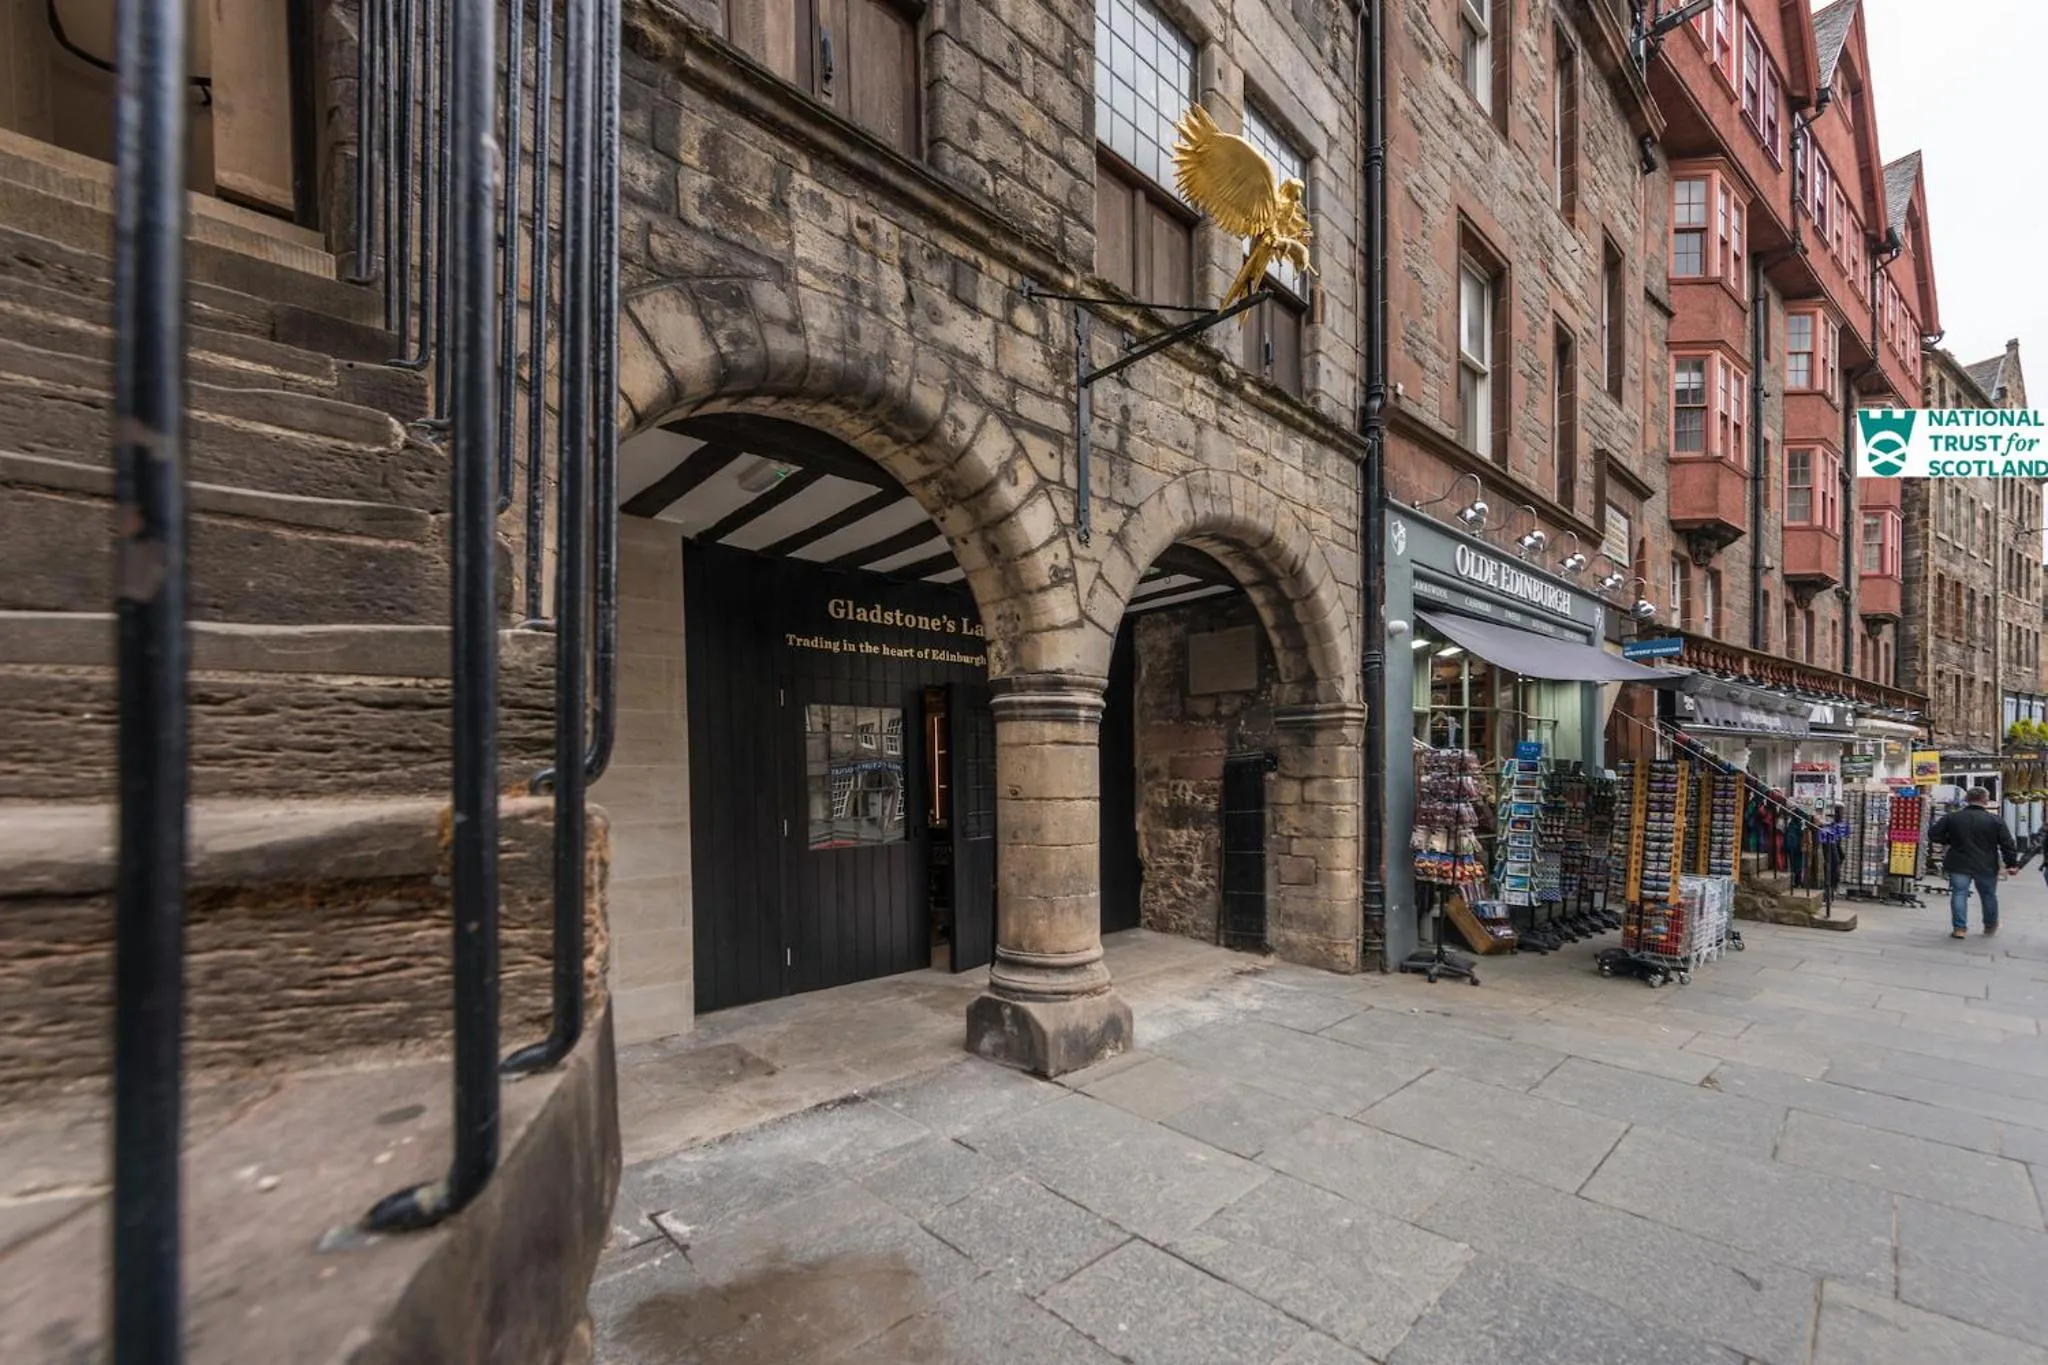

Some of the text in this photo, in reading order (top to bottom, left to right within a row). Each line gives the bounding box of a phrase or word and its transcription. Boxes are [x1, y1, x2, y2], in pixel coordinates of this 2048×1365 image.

[1455, 544, 1571, 615] OLDE EDINBURGH
[827, 598, 956, 632] Gladstone's
[785, 633, 987, 667] Trading in the heart of Edinburgh
